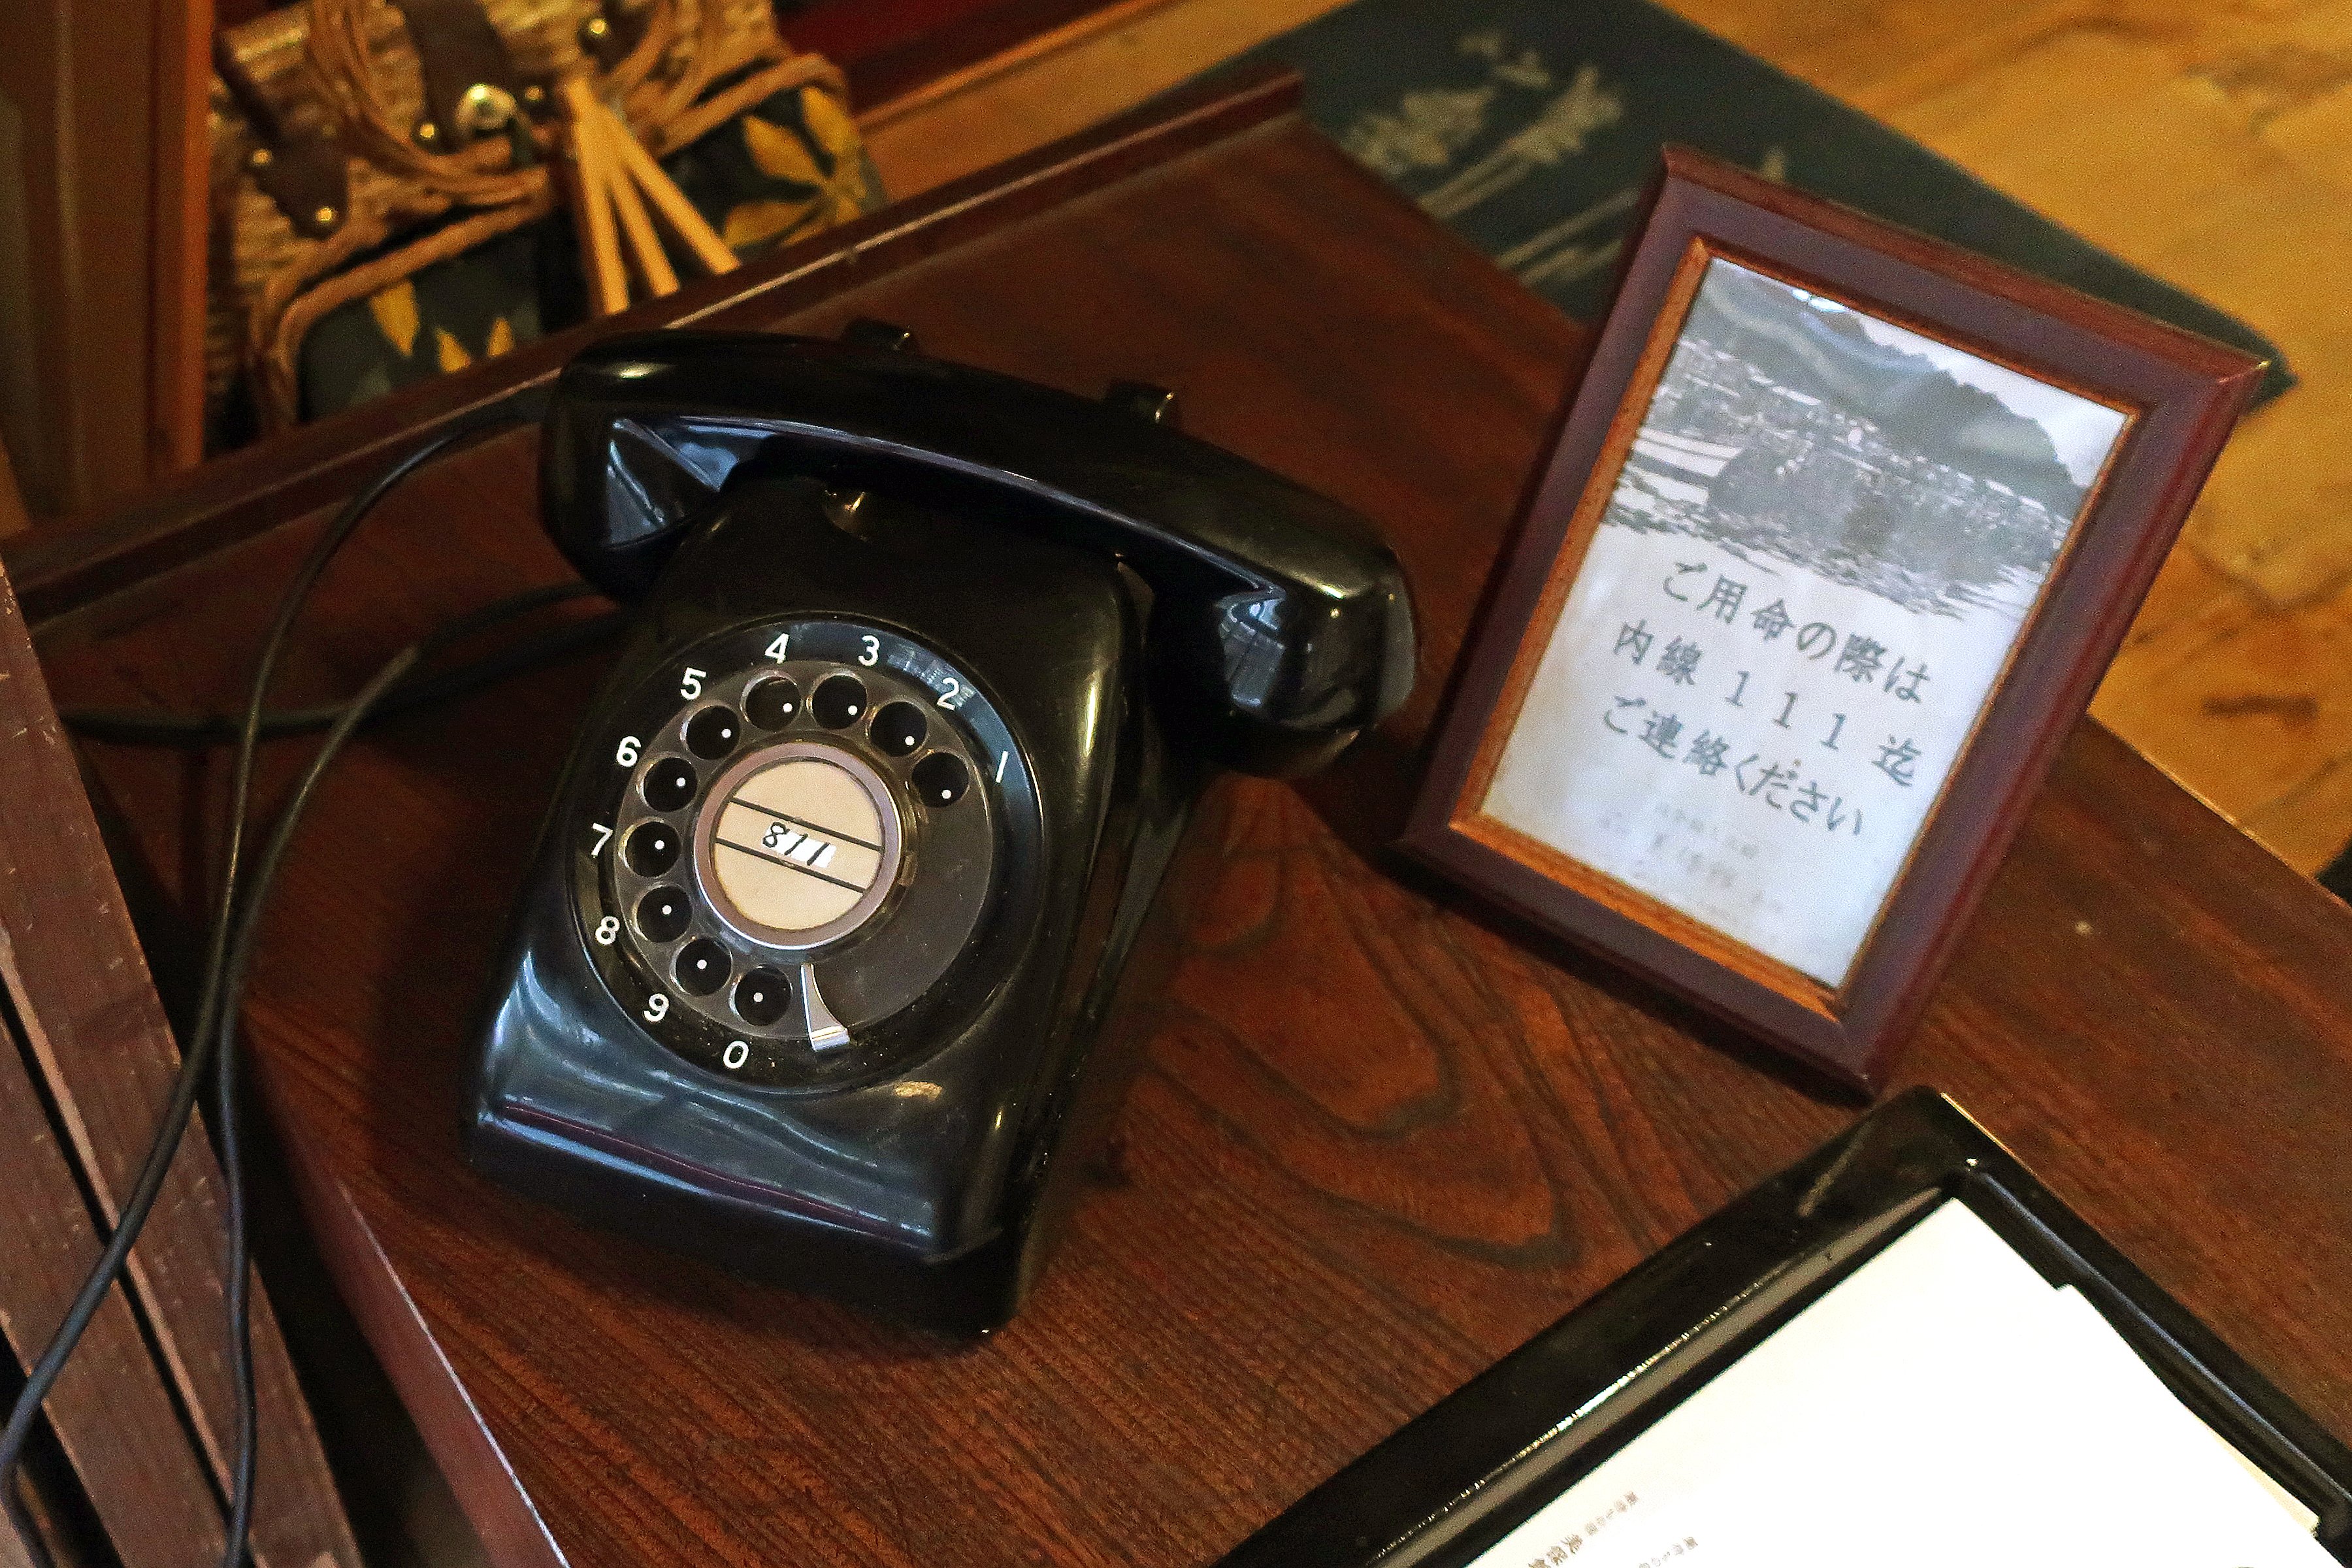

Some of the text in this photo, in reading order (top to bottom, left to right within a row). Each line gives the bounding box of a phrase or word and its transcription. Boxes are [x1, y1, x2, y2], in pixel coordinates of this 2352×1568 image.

[764, 633, 789, 664] 4
[1662, 561, 1931, 703] ご用命の際は
[858, 635, 880, 666] 3
[680, 666, 707, 700] 5
[936, 677, 960, 711] 2
[616, 736, 642, 768] 6
[995, 750, 1009, 783] 1
[1603, 693, 1865, 838] ご連絡ください
[591, 823, 613, 856] 7
[762, 821, 831, 866] 811
[595, 916, 620, 945] 8
[644, 993, 670, 1022] 9
[723, 1041, 749, 1069] 0
